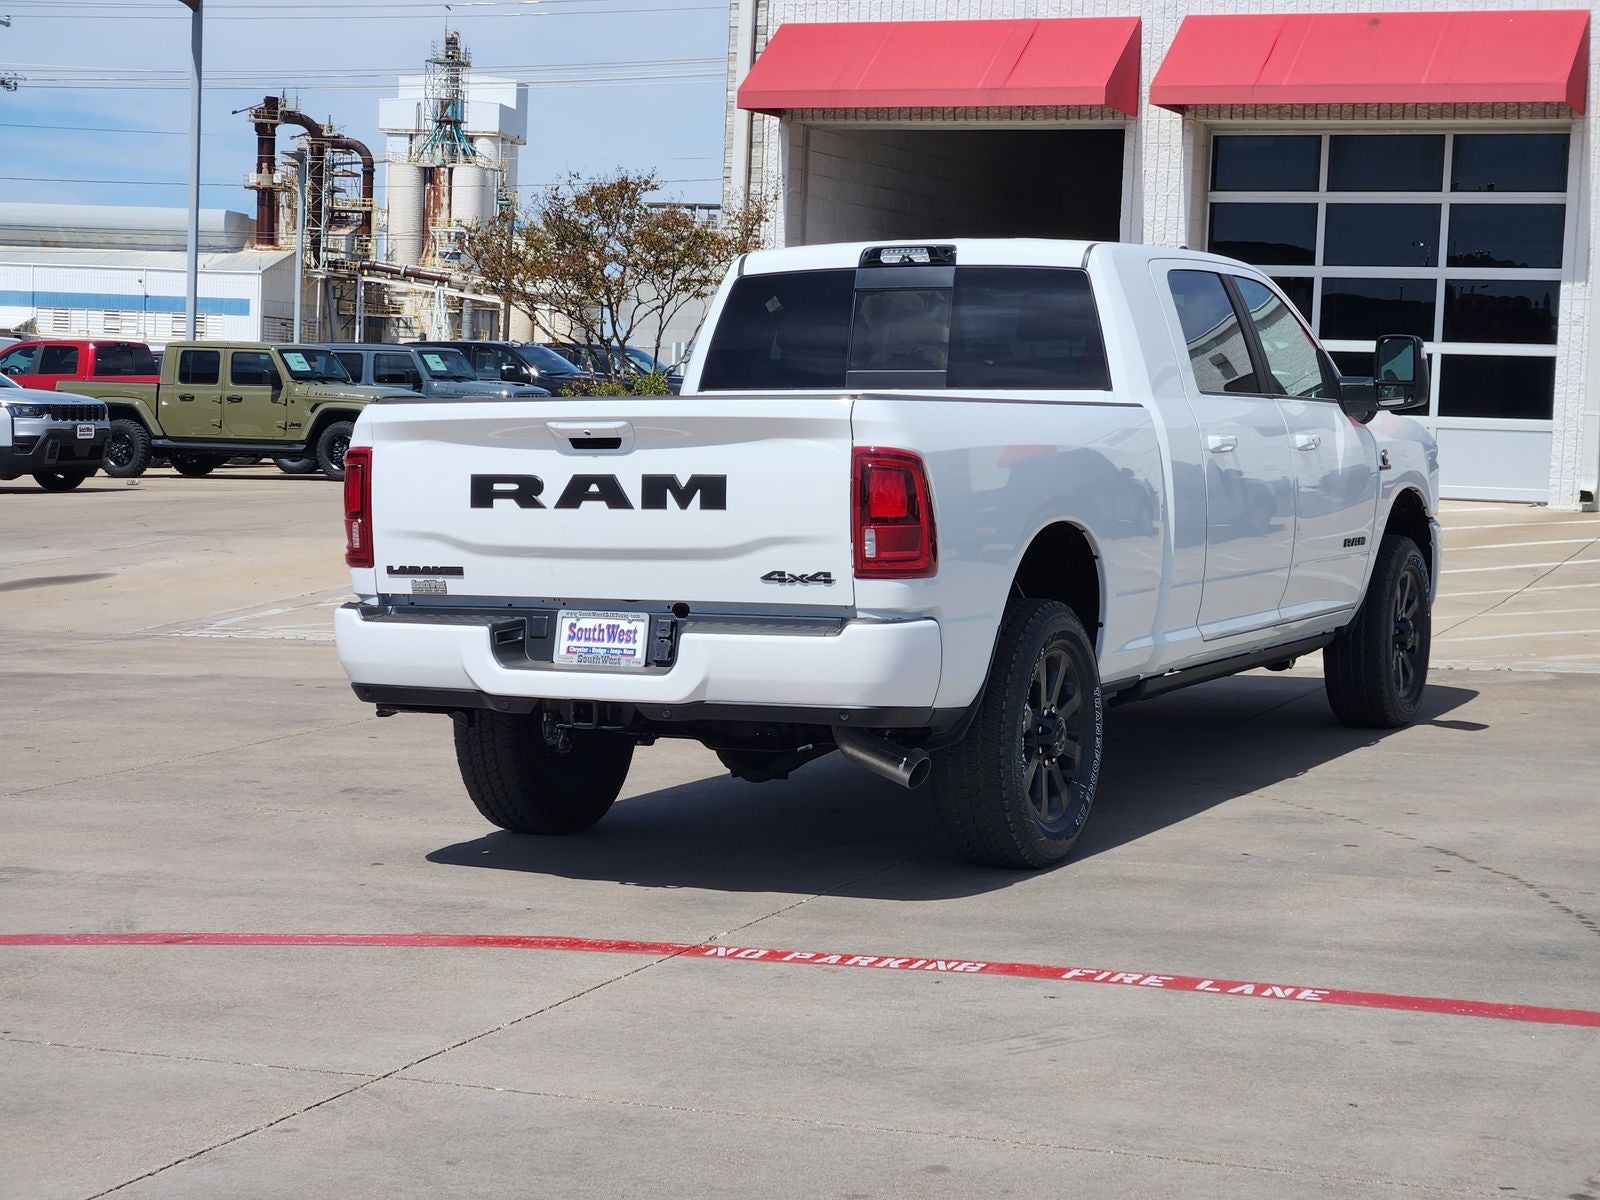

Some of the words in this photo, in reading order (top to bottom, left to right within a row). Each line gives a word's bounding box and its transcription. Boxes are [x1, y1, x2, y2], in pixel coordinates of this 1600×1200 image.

[471, 474, 727, 510] RAM
[1343, 536, 1366, 547] RAM
[567, 622, 638, 645] SouthWest
[577, 654, 621, 665] SouthWest
[705, 946, 768, 959] NO
[782, 951, 987, 973] PARKING
[1061, 968, 1174, 987] FIRE
[1196, 980, 1330, 1001] LANE
